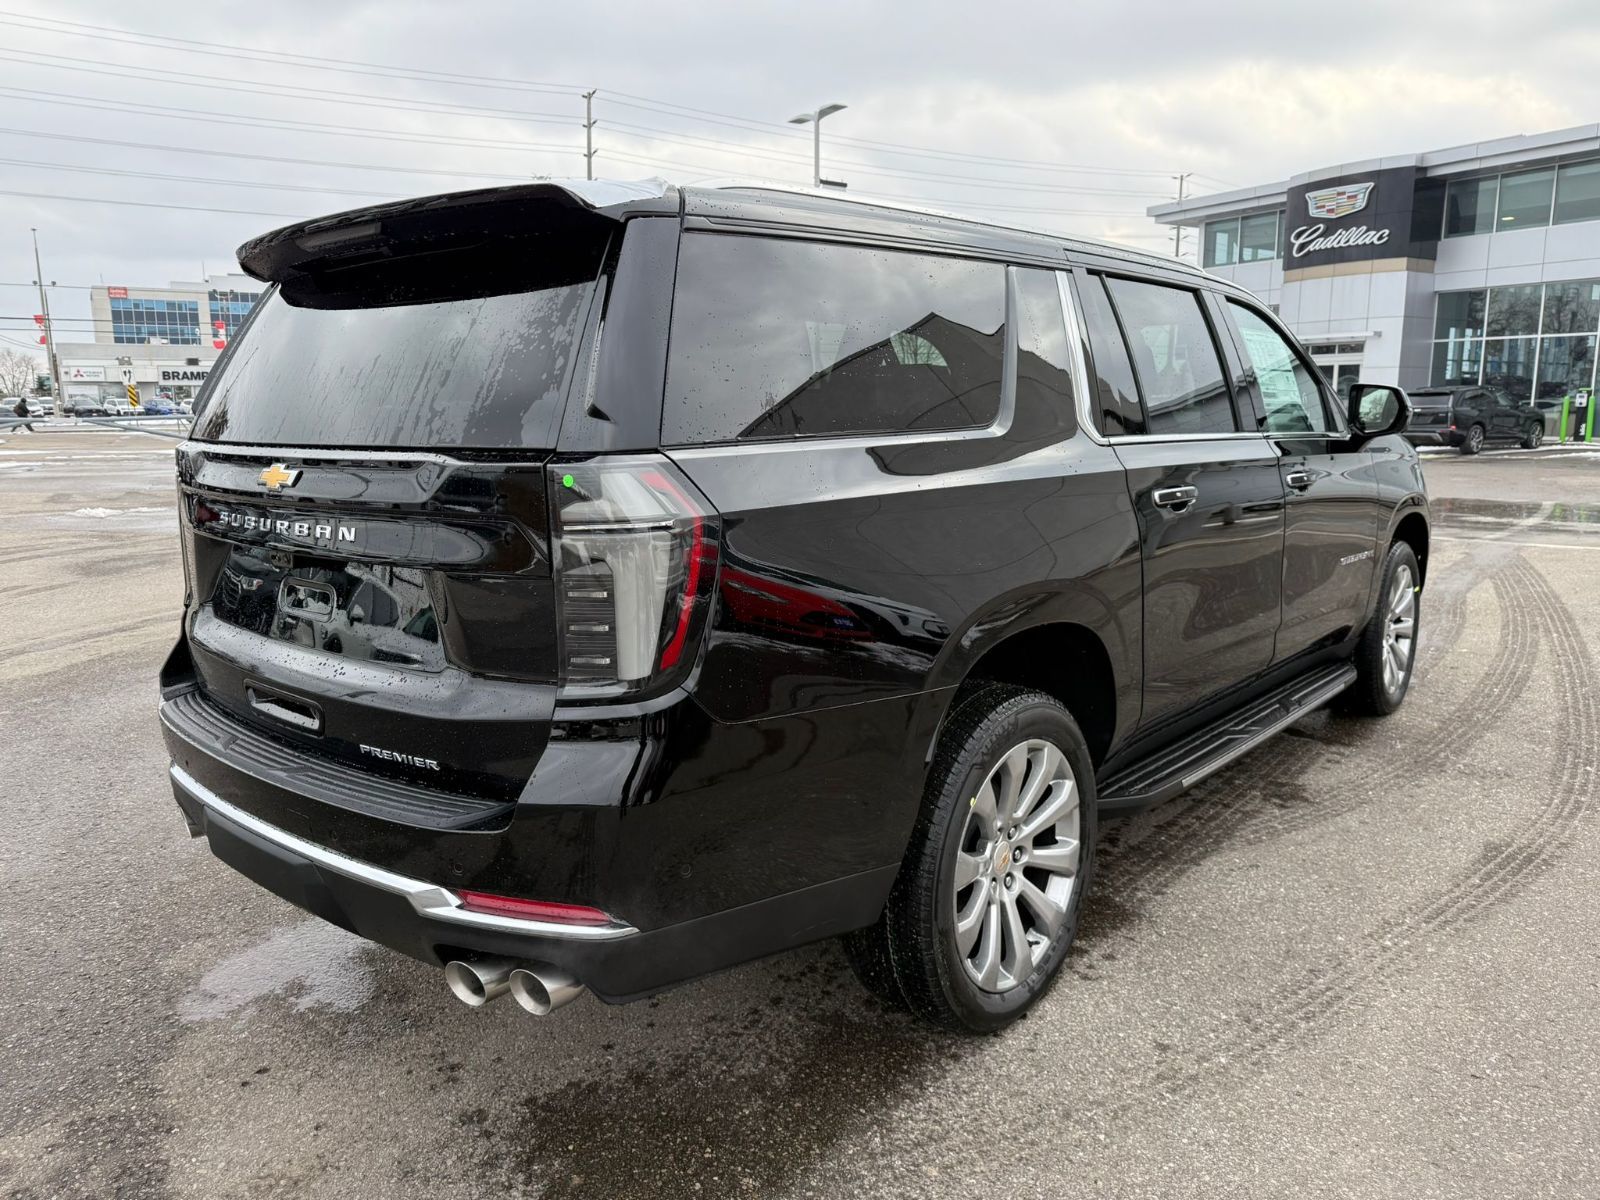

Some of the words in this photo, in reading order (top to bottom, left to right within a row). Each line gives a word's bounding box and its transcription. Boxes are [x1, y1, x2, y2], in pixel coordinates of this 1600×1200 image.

[1291, 224, 1390, 257] Cadillac
[219, 511, 355, 541] SUBURBAN
[359, 744, 440, 770] PREMIER
